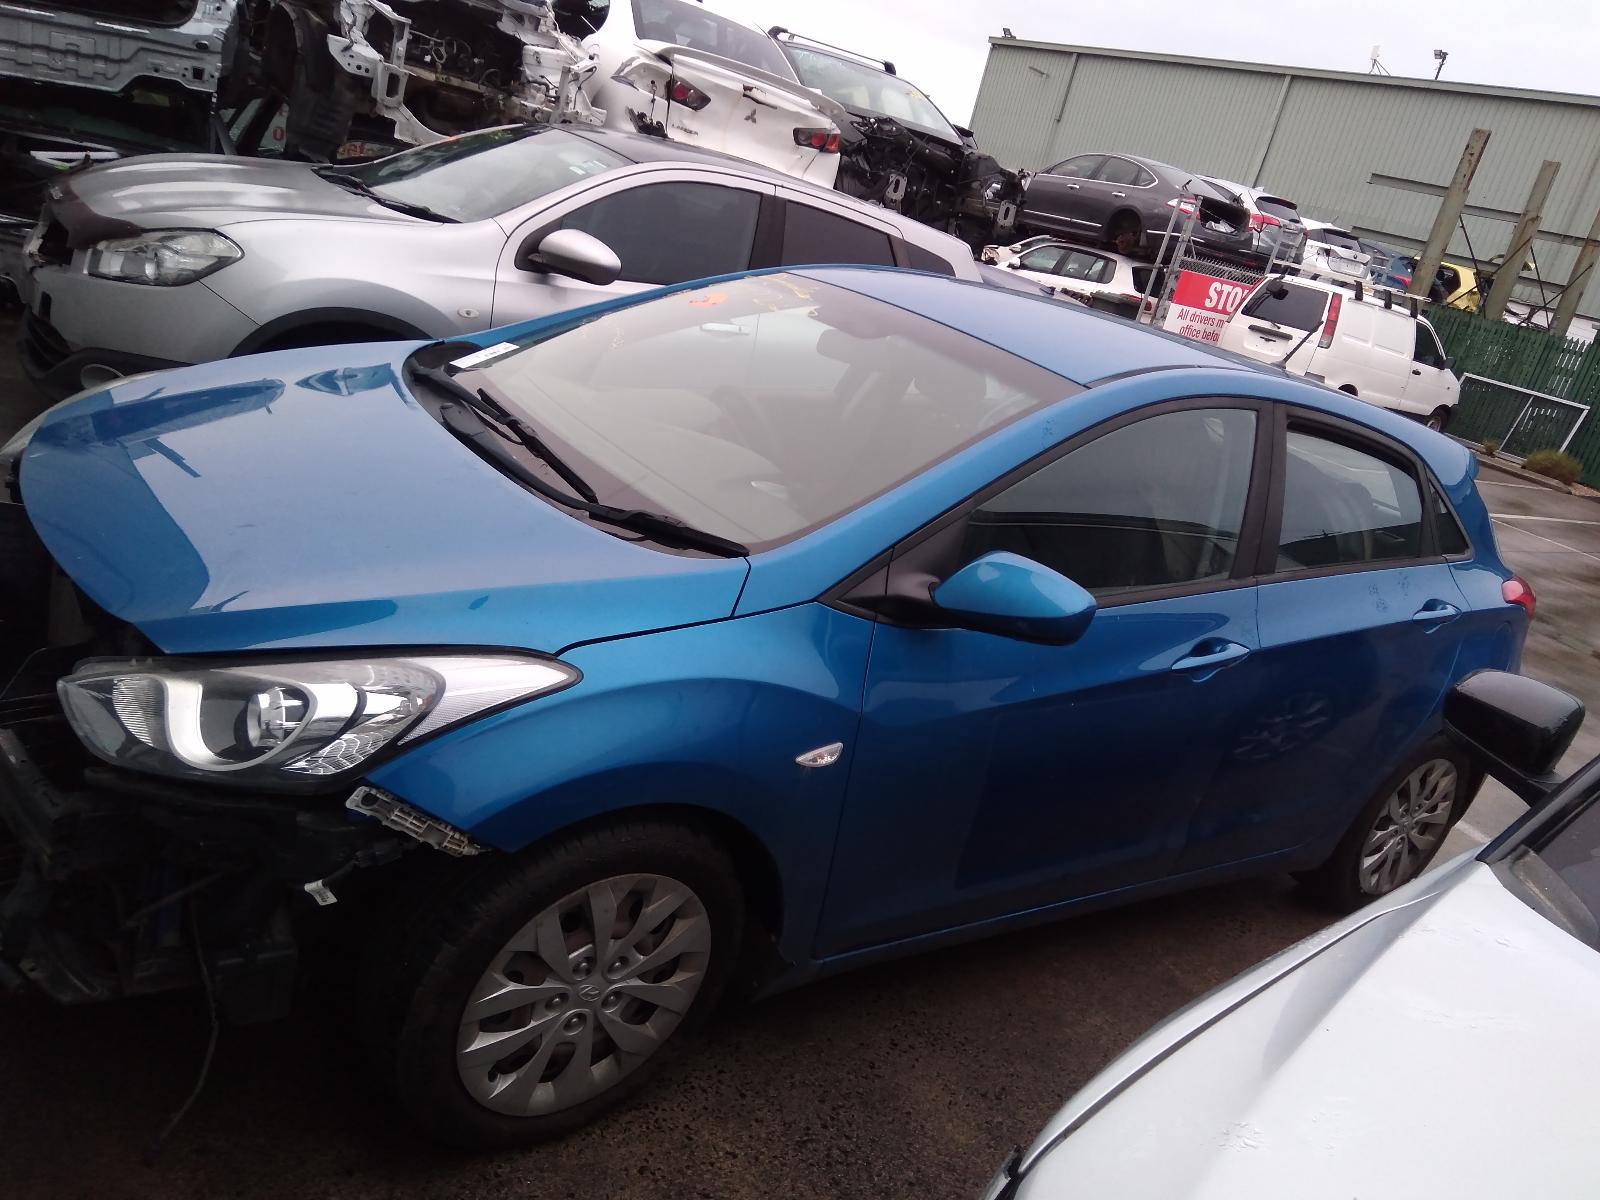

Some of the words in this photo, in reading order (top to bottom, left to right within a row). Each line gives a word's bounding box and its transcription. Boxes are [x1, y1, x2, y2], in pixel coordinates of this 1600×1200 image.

[1204, 281, 1249, 313] STO
[1177, 308, 1190, 321] All
[1189, 311, 1216, 327] drivers
[1215, 318, 1225, 329] m
[1179, 324, 1201, 339] office
